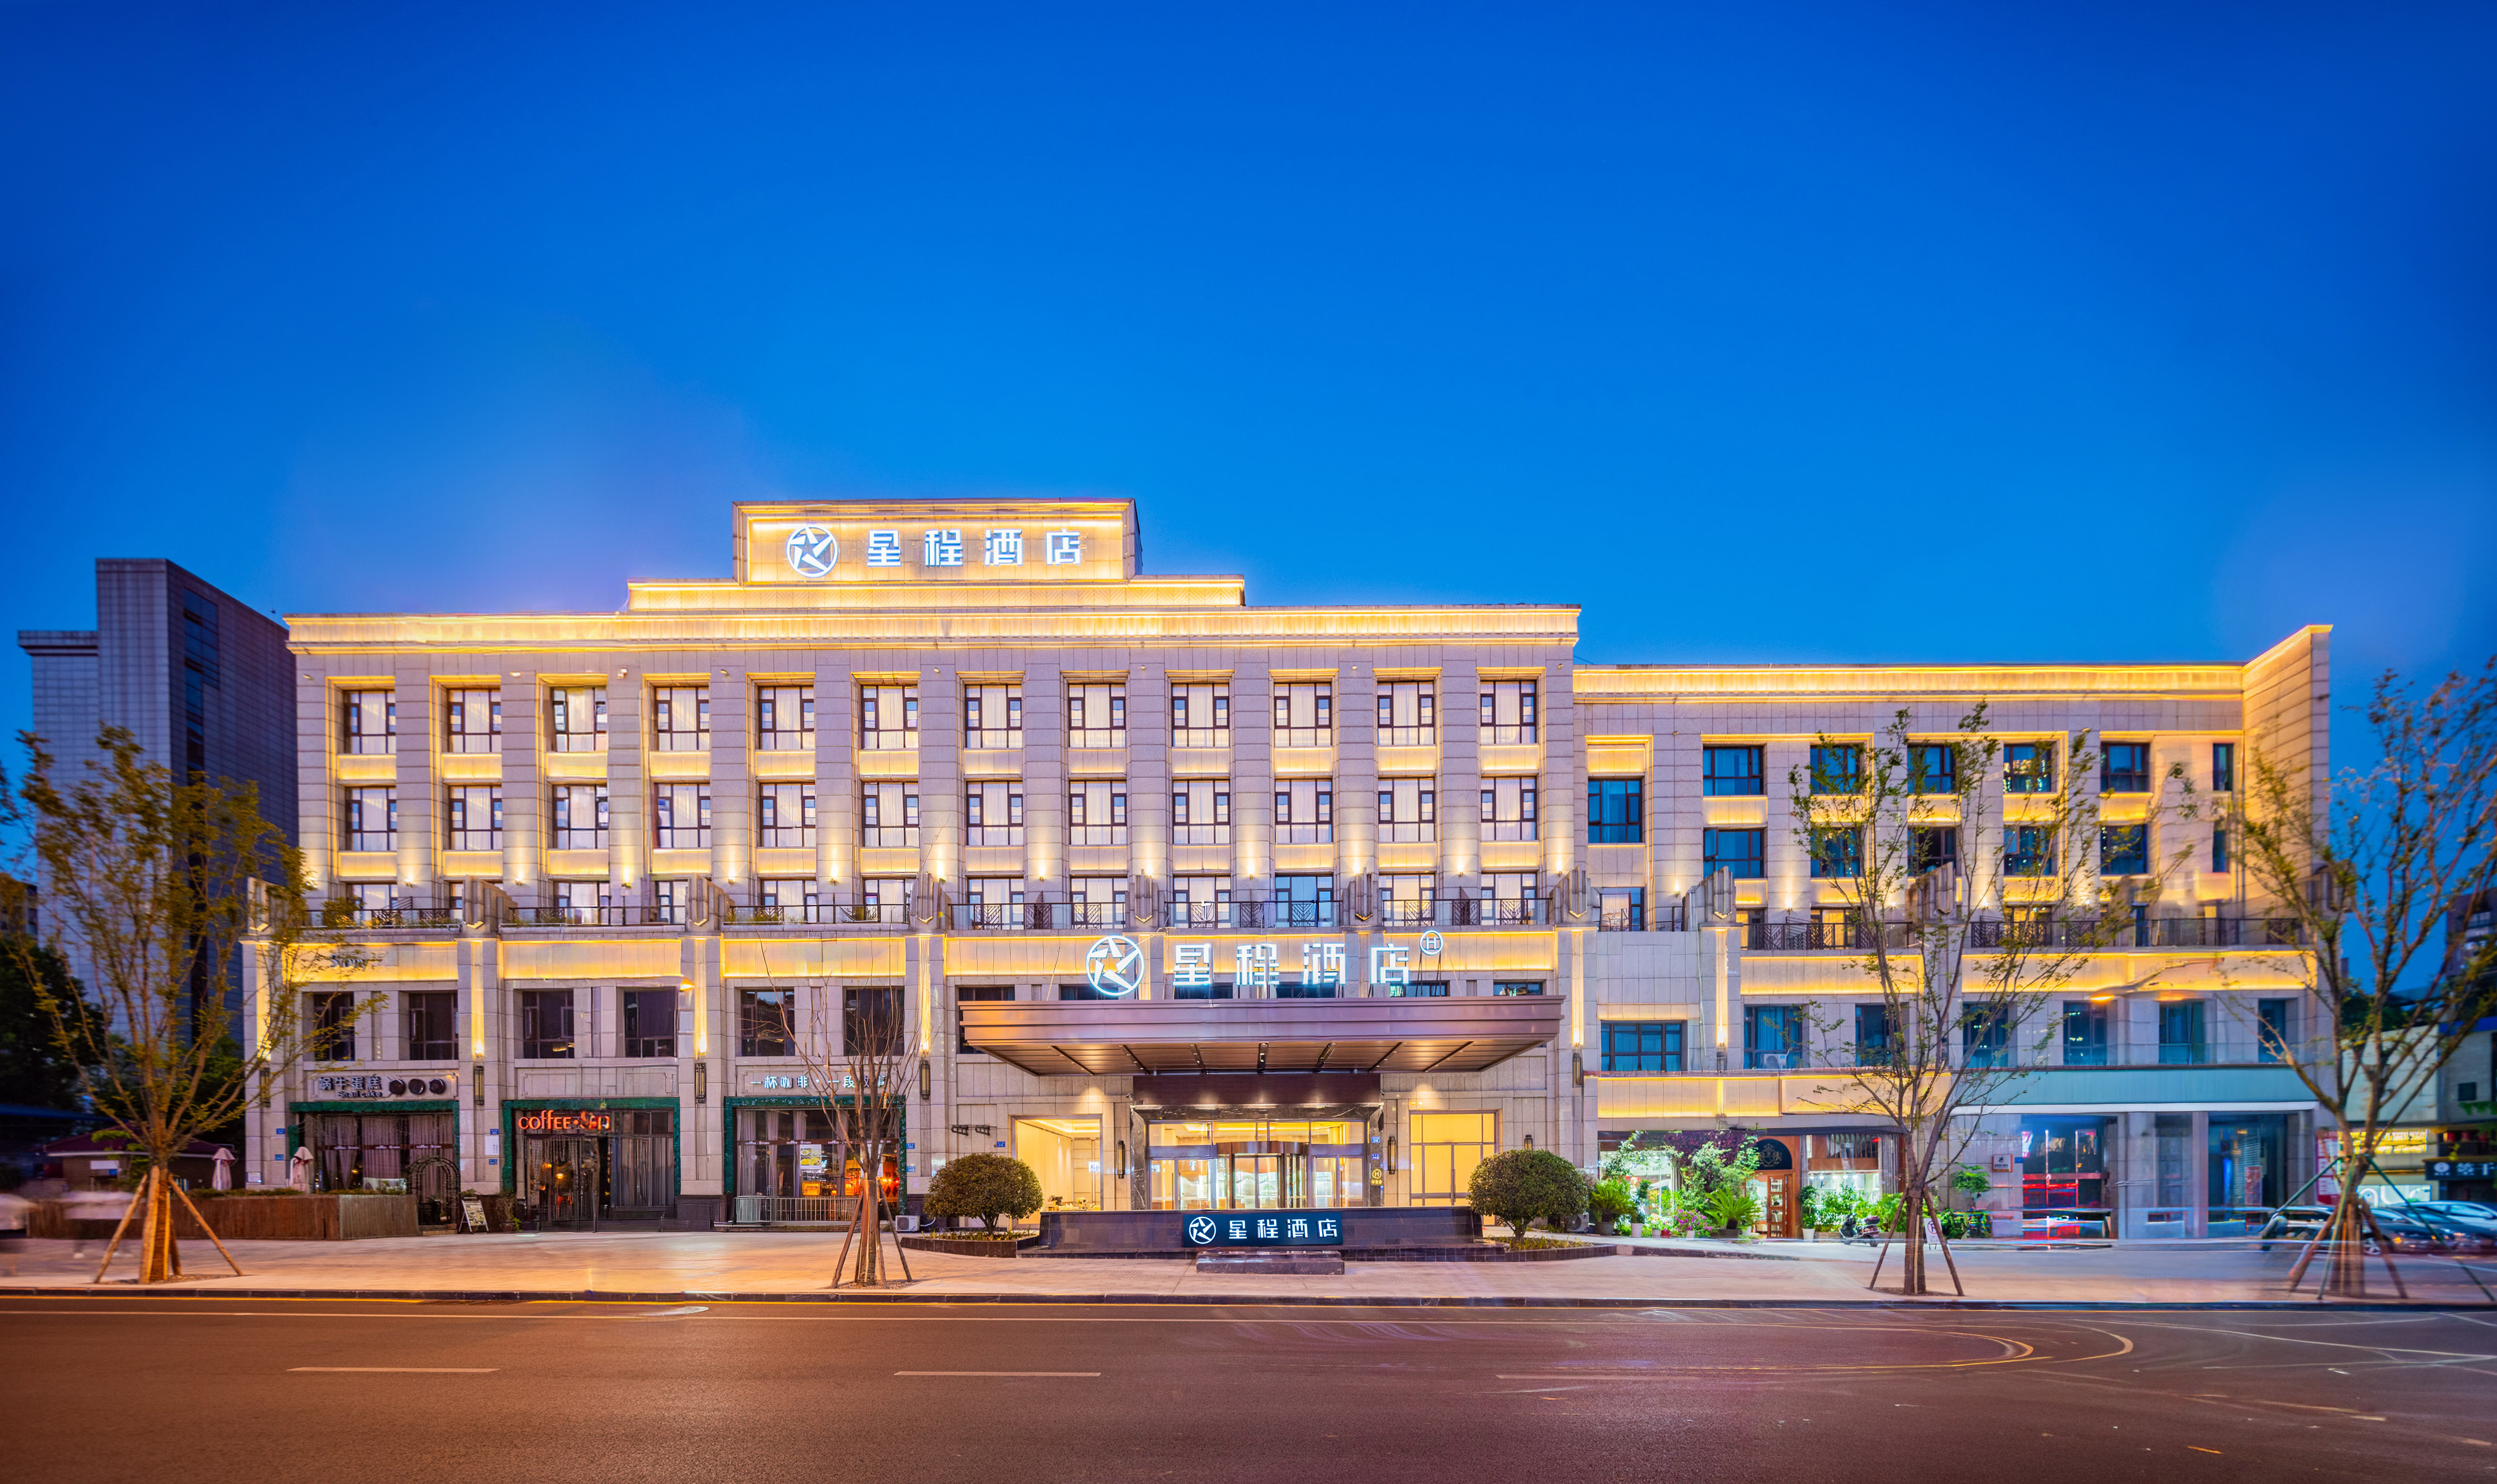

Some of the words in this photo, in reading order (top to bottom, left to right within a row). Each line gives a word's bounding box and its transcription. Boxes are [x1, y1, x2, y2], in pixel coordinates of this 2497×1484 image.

[866, 528, 1081, 568] 星程酒店
[1172, 942, 1410, 987] 星程酒店
[318, 1076, 381, 1090] 蜗牛蛋糕
[1229, 1218, 1338, 1240] 星程酒店
